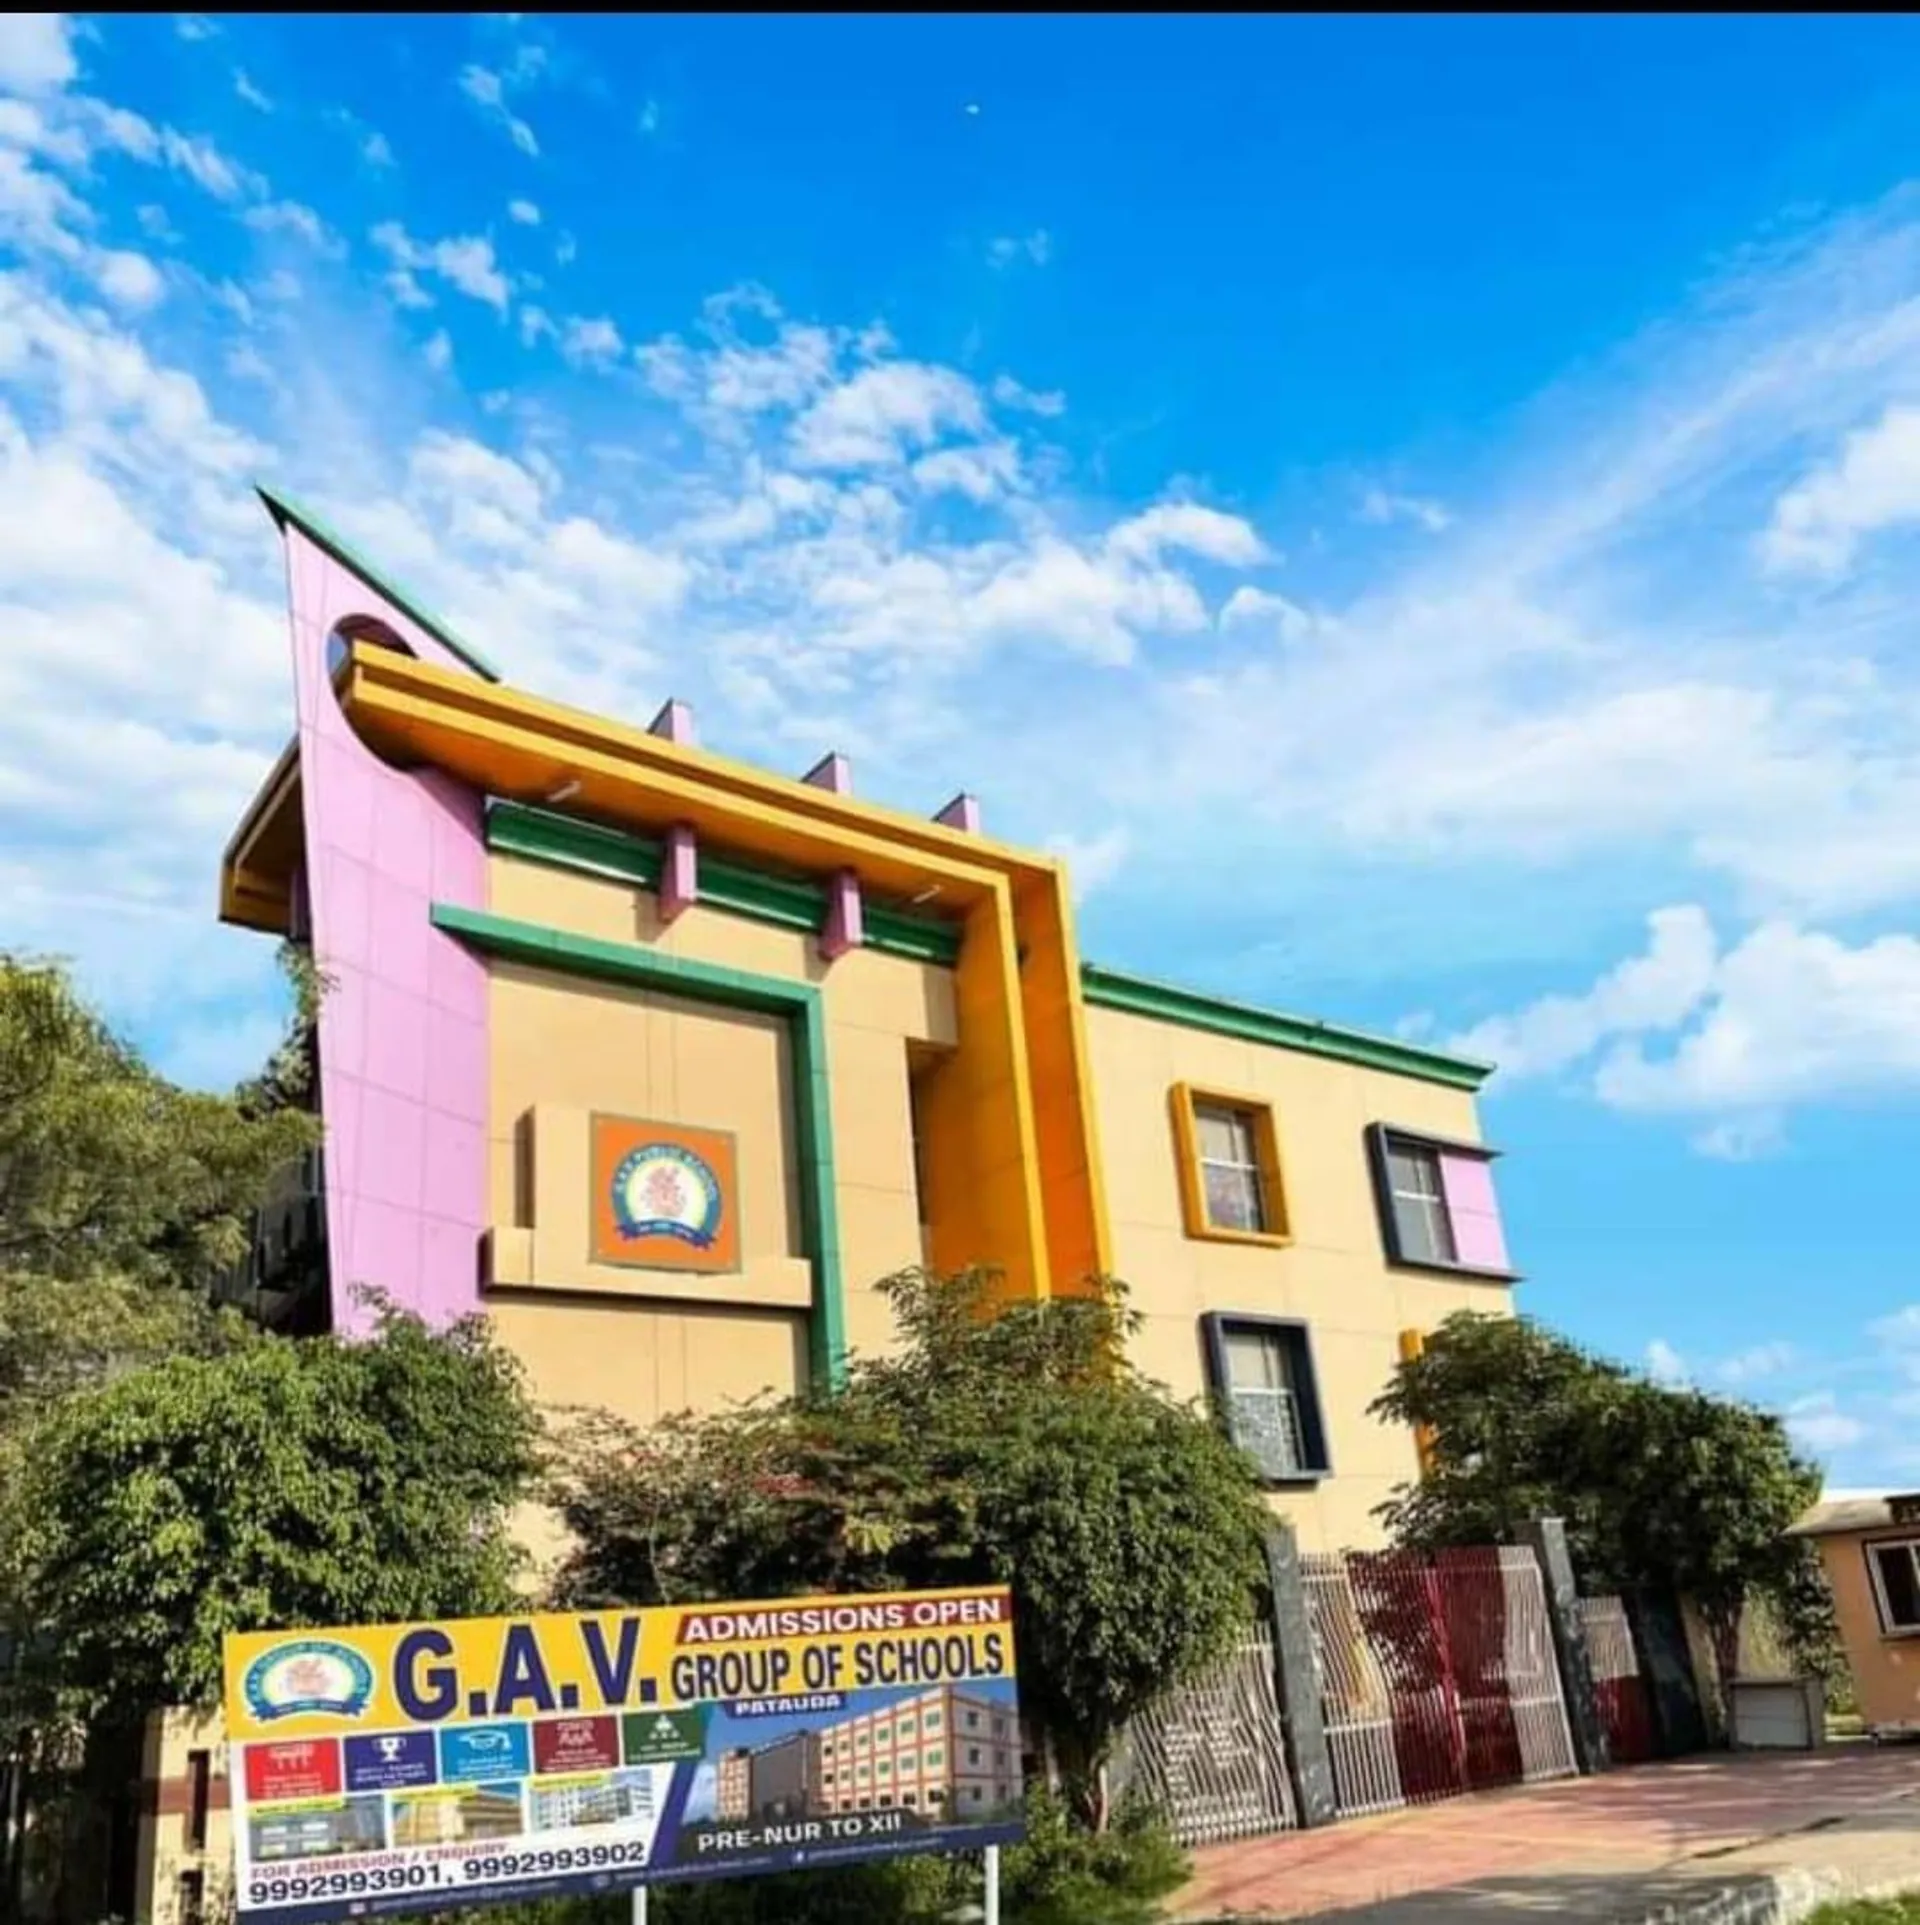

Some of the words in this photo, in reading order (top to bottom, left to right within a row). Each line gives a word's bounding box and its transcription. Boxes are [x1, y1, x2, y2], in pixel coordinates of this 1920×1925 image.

[685, 1606, 902, 1642] ADMISSIONS
[913, 1598, 1000, 1626] OPEN
[394, 1617, 657, 1721] G.A.V.
[671, 1648, 790, 1700] GROUP
[802, 1645, 844, 1690] OF
[855, 1633, 1005, 1686] SCHOOLS
[698, 1824, 821, 1852] PRE-NUR
[831, 1819, 862, 1837] TO
[869, 1815, 902, 1834] XII
[249, 1864, 453, 1904] 9992993901,
[464, 1841, 645, 1880] 9992993902
[251, 1865, 290, 1880] FOR
[296, 1852, 406, 1876] ADMISSION
